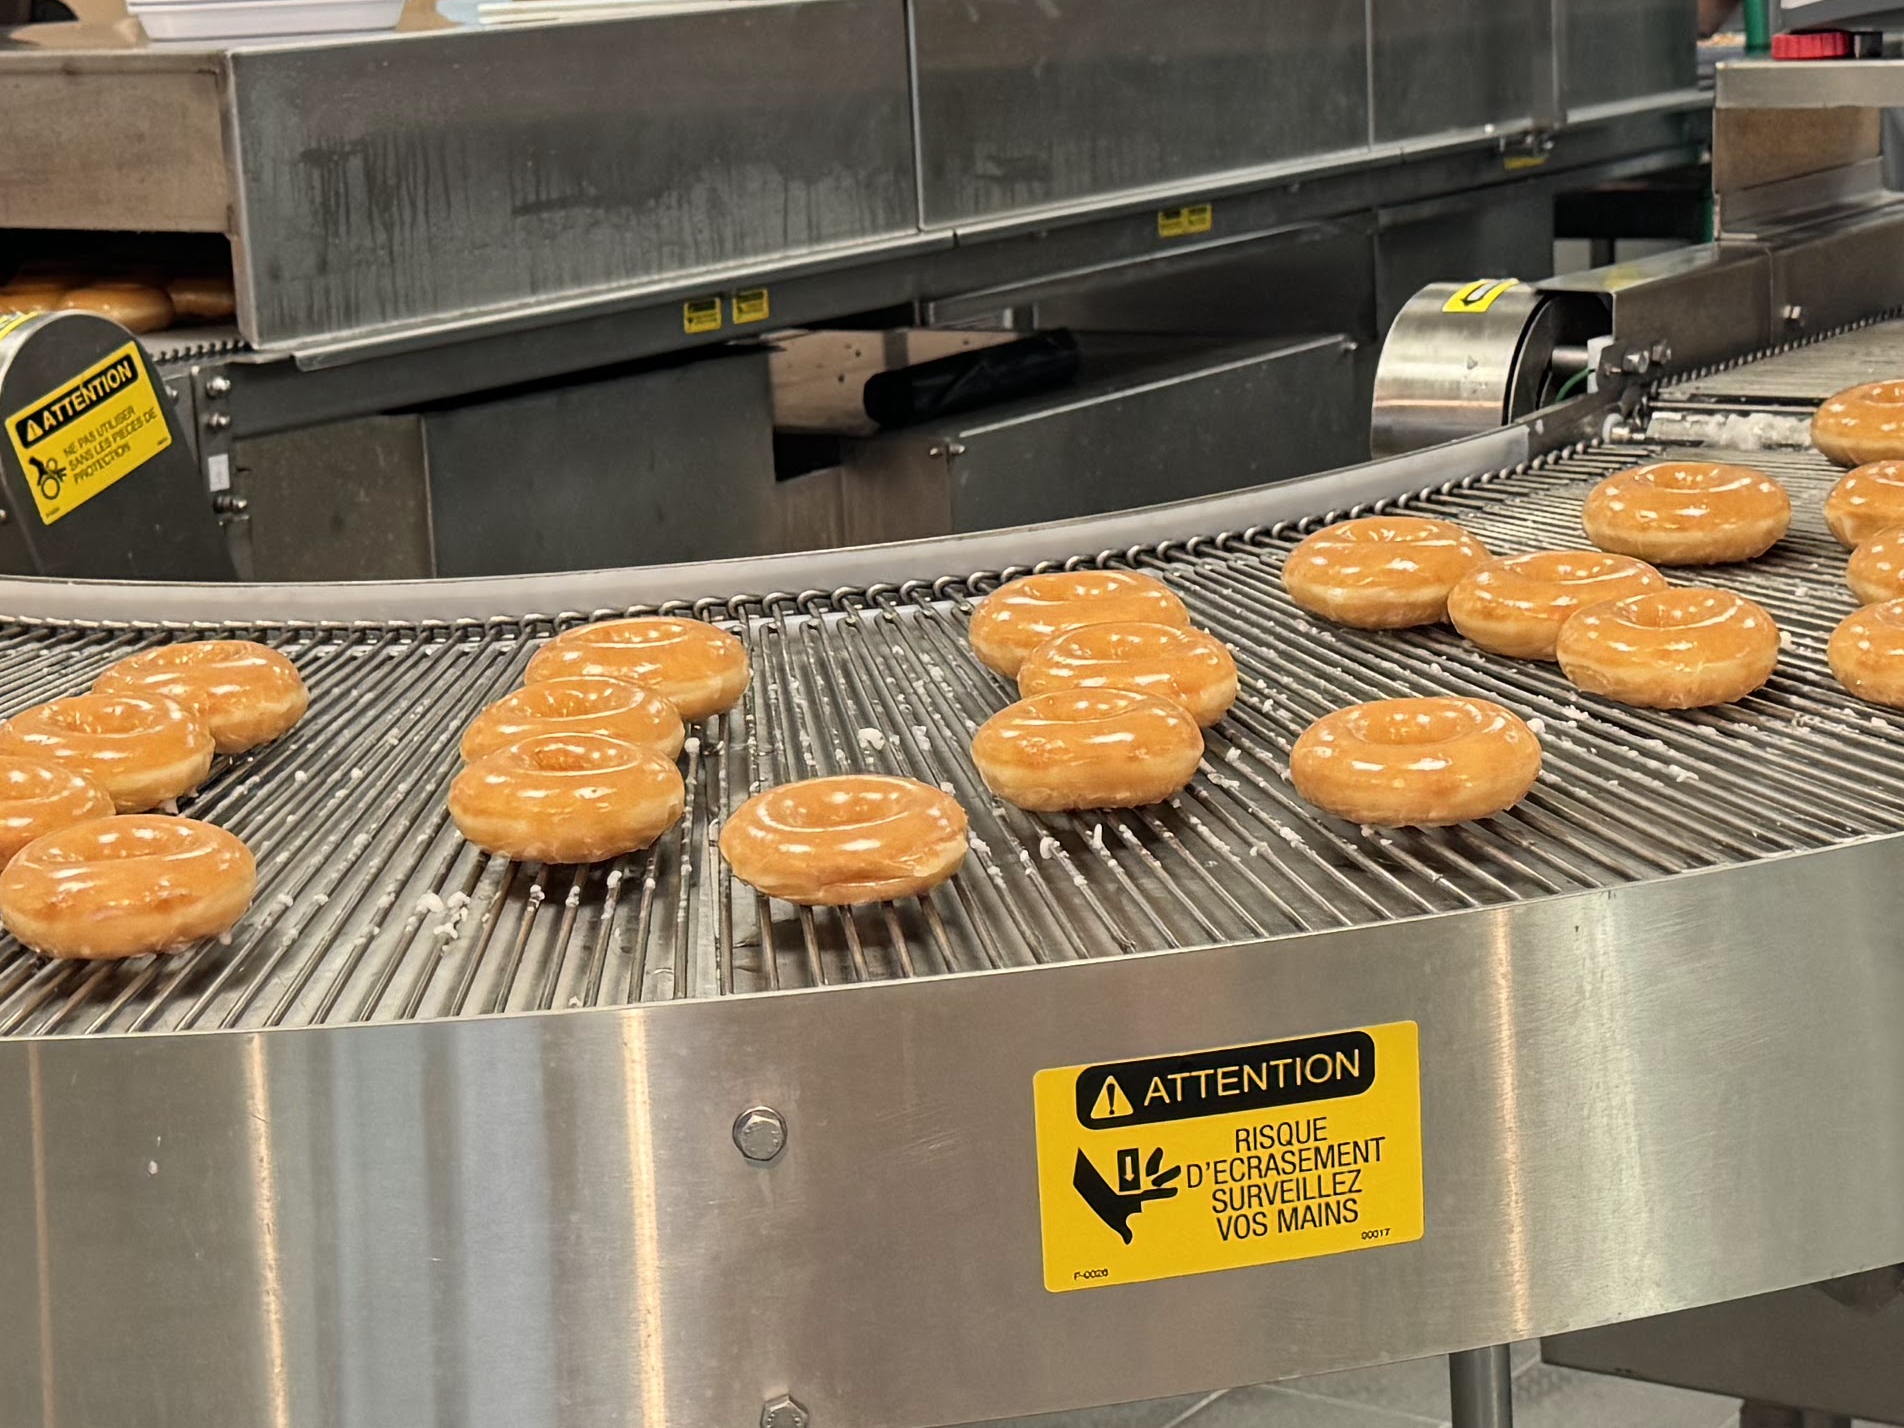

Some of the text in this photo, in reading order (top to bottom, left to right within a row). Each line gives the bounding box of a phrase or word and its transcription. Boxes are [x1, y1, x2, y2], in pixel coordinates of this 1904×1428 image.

[43, 361, 132, 431] ATTENTION
[77, 430, 96, 449] PAS
[94, 437, 112, 455] LES
[1143, 1048, 1360, 1107] ATTENTION
[1235, 1116, 1328, 1153] RISQUE
[1186, 1136, 1386, 1189] D'ECRASEMENT
[1211, 1169, 1363, 1214] SURVEILLEZ
[1216, 1198, 1359, 1241] VOS MAINS
